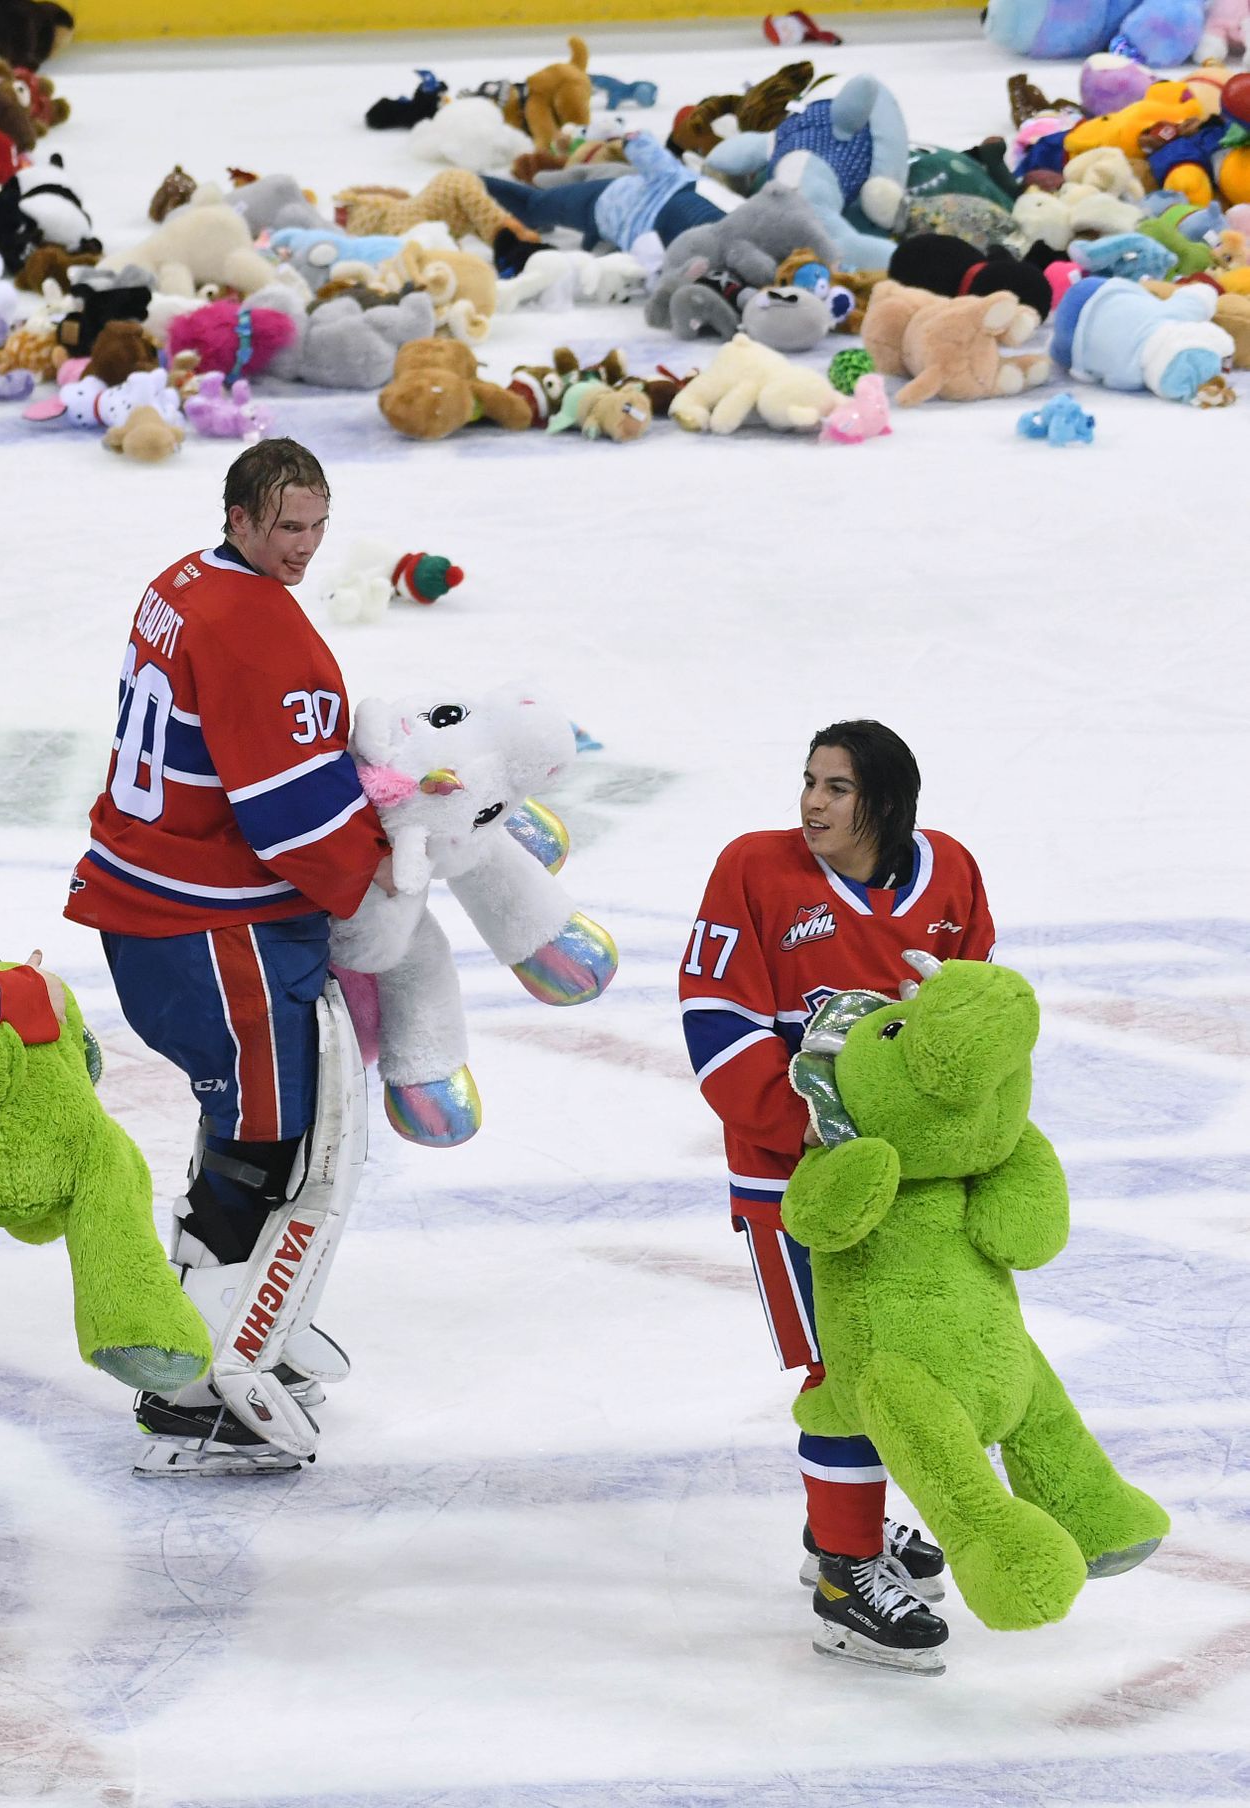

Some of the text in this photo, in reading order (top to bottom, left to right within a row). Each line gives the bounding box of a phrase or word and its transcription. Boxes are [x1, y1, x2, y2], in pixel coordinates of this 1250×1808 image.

[183, 562, 202, 579] CCM
[136, 586, 184, 660] BEAUPIT
[282, 688, 341, 745] 30
[790, 913, 836, 944] WHL
[926, 919, 963, 934] CM
[684, 919, 740, 980] 17
[194, 1078, 228, 1093] CM
[233, 1220, 316, 1363] VAUGHN
